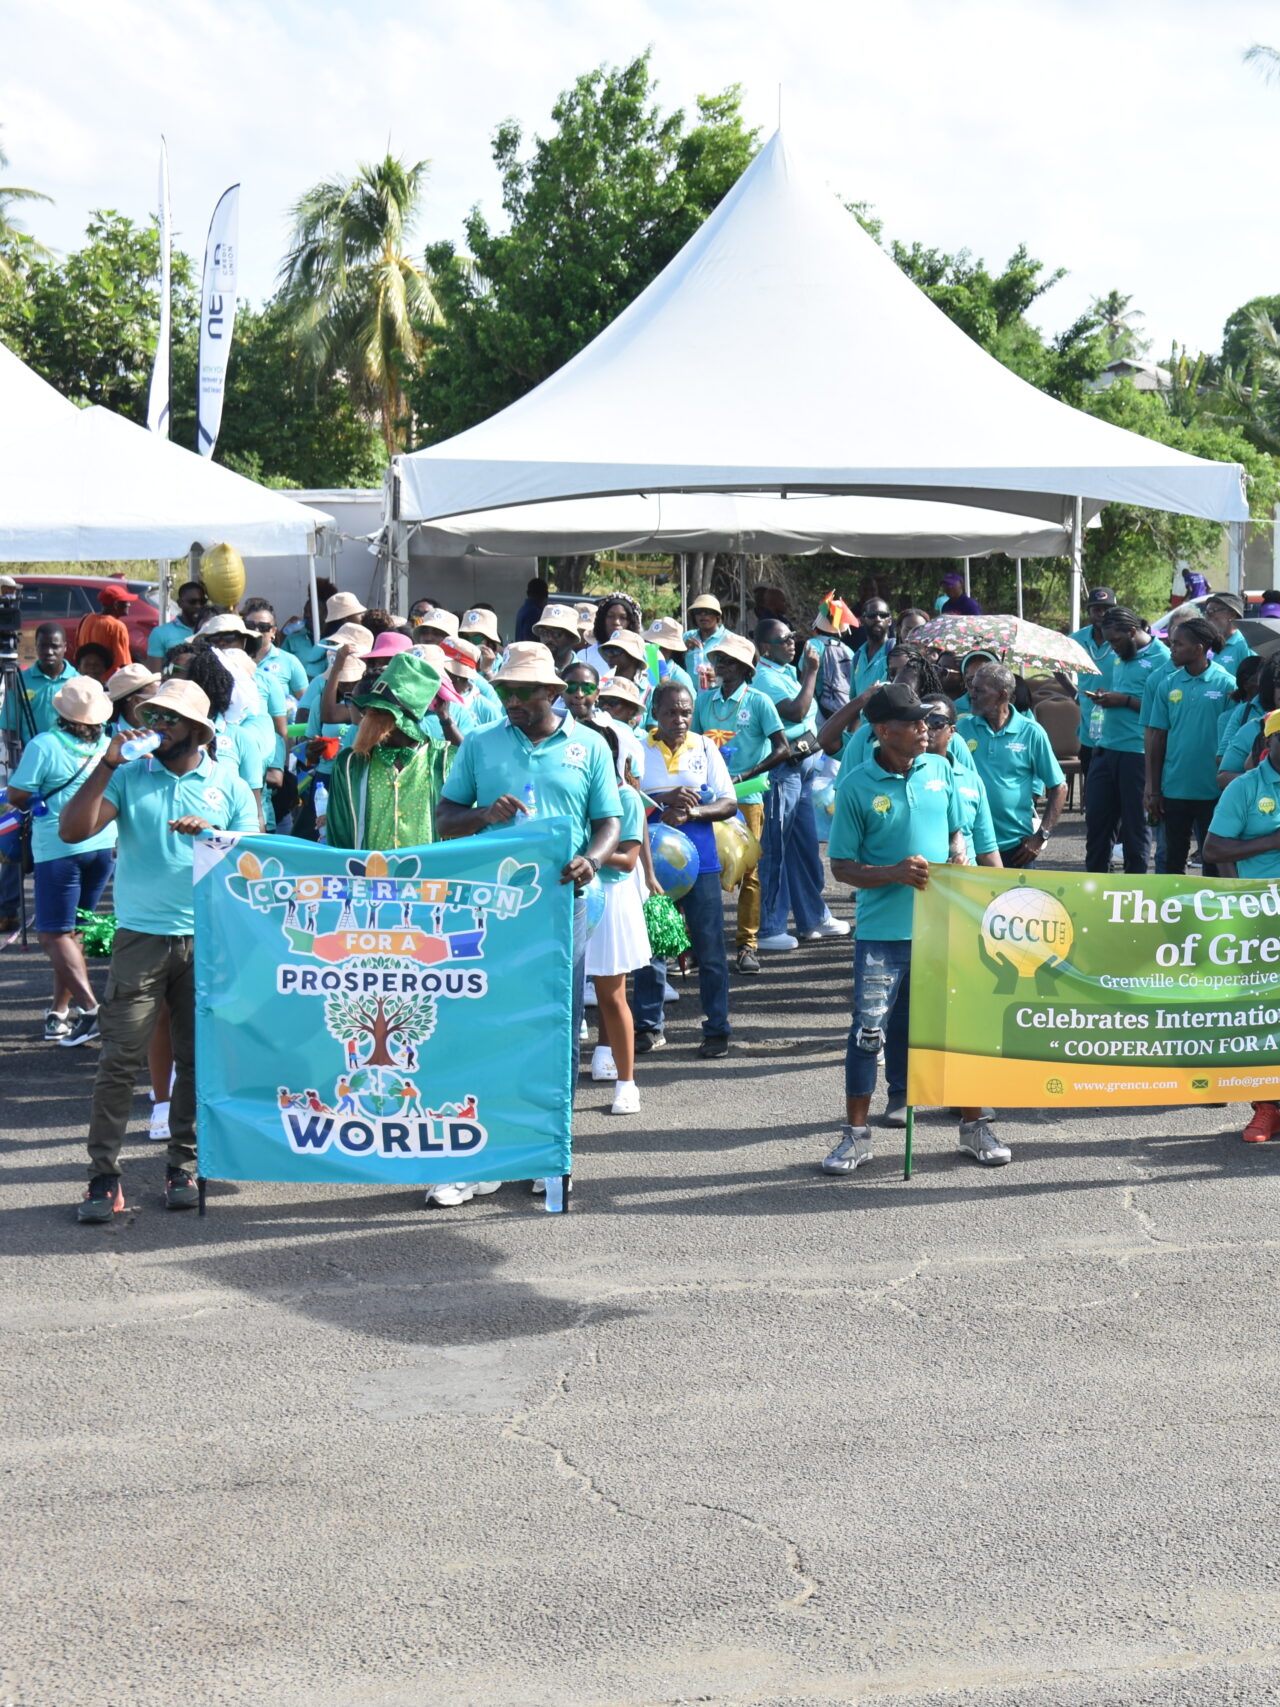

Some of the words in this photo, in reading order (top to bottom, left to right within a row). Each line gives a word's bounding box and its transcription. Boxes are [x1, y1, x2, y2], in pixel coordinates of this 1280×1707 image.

[254, 878, 518, 912] COOPERATION
[1103, 889, 1182, 924] The
[989, 914, 1059, 943] GCCU
[346, 933, 392, 950] FOR
[401, 934, 417, 951] A
[1156, 934, 1203, 967] of
[282, 969, 484, 994] PROSPEROUS
[1100, 974, 1174, 988] Grenville
[1178, 969, 1278, 990] Co-operative
[1016, 1008, 1149, 1030] Celebrates
[1064, 1039, 1214, 1057] COOPERATION
[1219, 1035, 1260, 1054] FOR
[1263, 1034, 1279, 1050] A
[1073, 1080, 1178, 1091] www.grencu.com
[288, 1114, 483, 1152] WORLD
